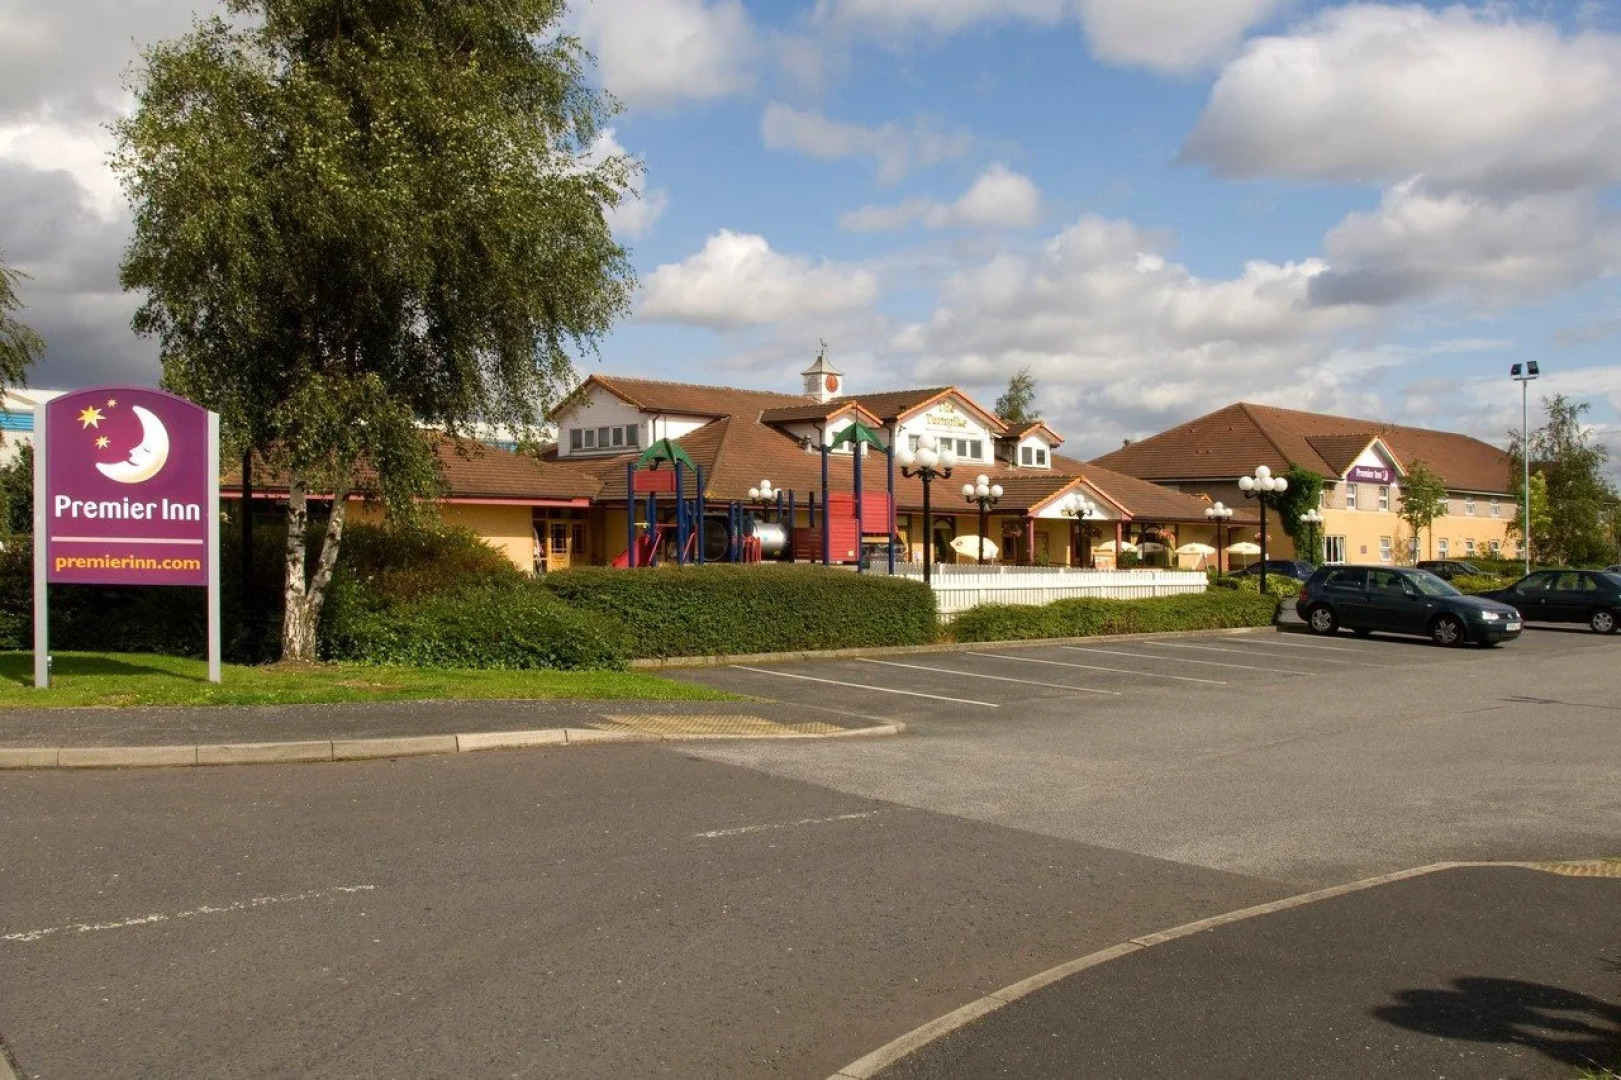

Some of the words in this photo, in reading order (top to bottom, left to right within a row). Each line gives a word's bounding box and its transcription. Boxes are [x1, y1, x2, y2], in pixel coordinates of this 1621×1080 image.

[54, 494, 158, 520] Premier
[161, 498, 201, 521] Inn
[55, 554, 201, 572] premierinn.com
